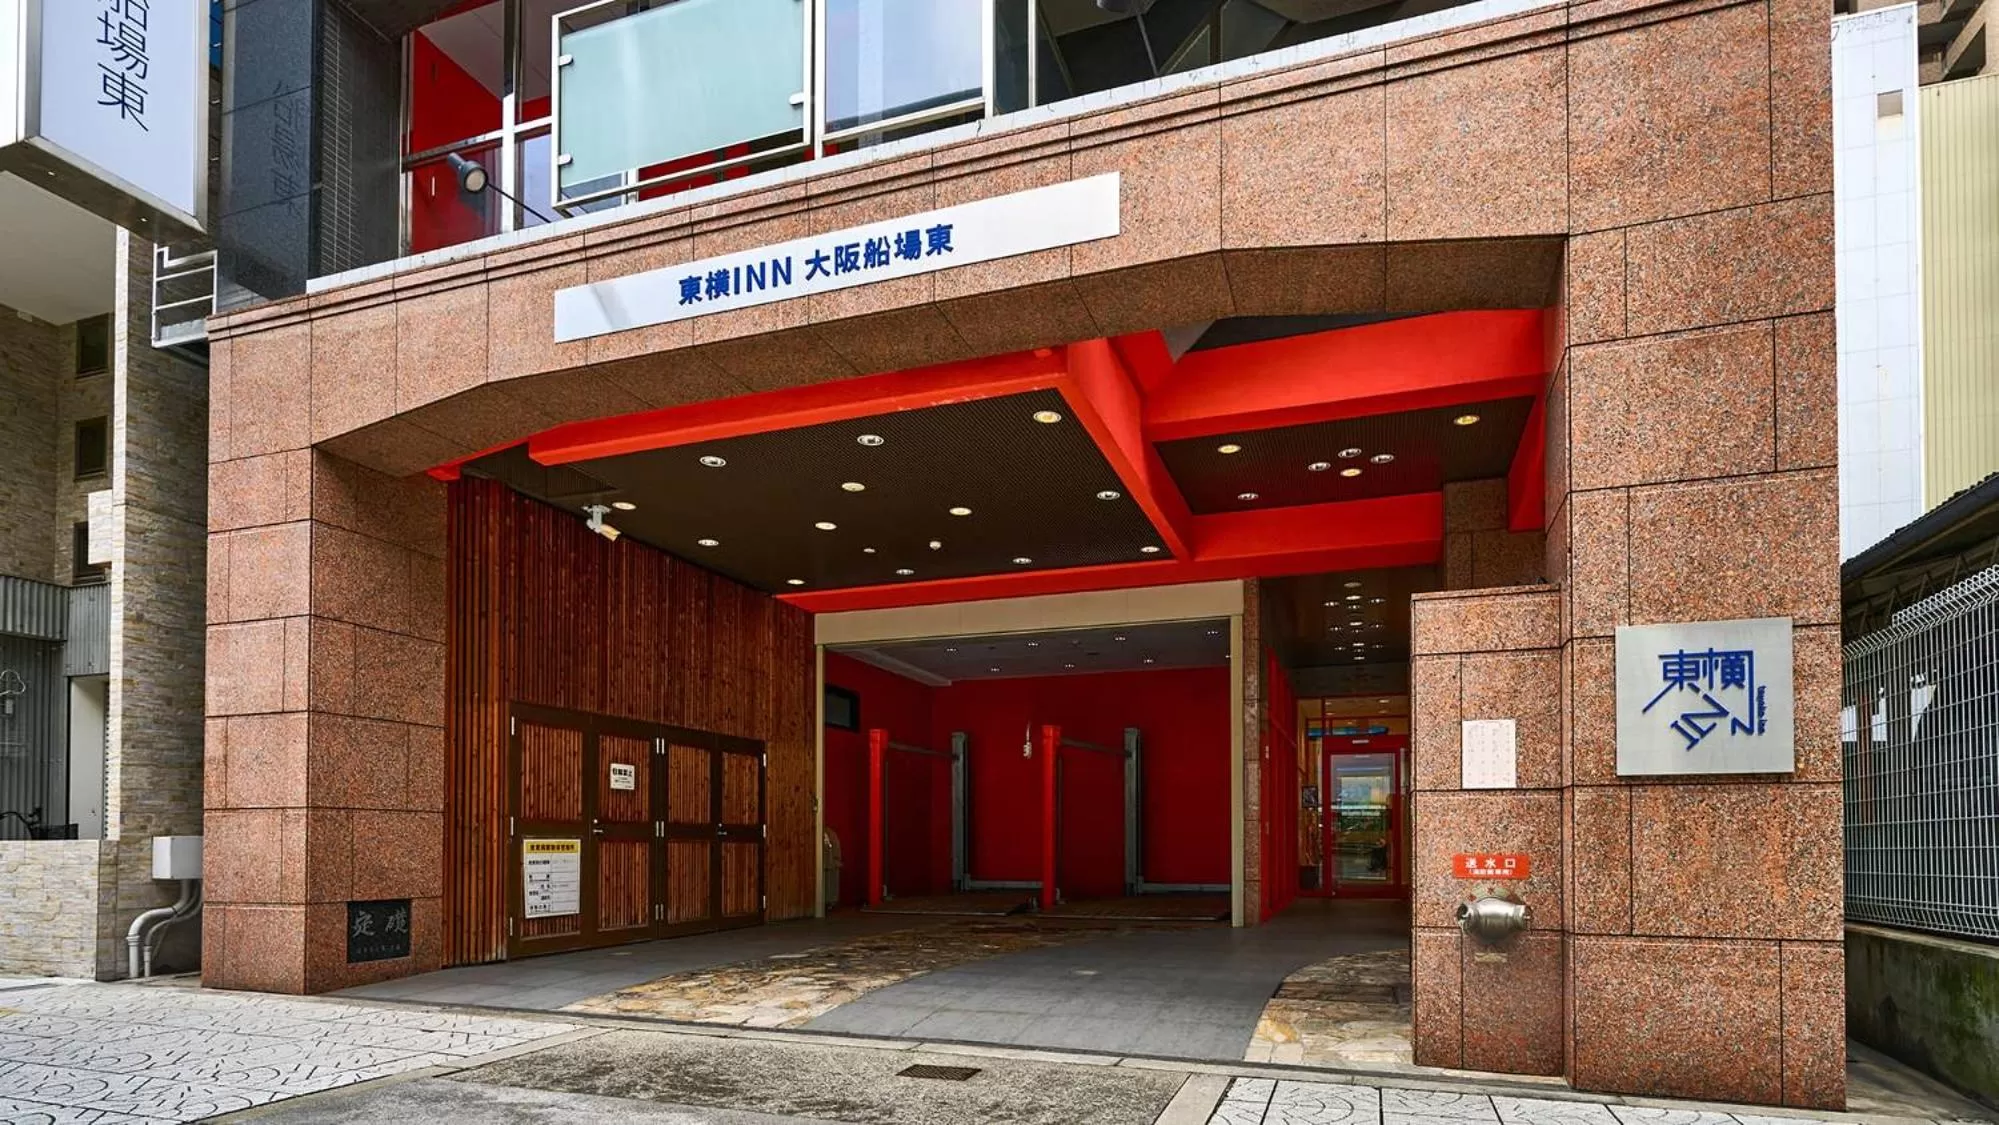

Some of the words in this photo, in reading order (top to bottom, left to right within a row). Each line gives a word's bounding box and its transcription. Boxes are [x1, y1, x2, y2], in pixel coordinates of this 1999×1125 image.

[678, 256, 792, 306] 東横INN
[804, 223, 955, 282] 大阪船場東
[1465, 857, 1516, 869] 送水口
